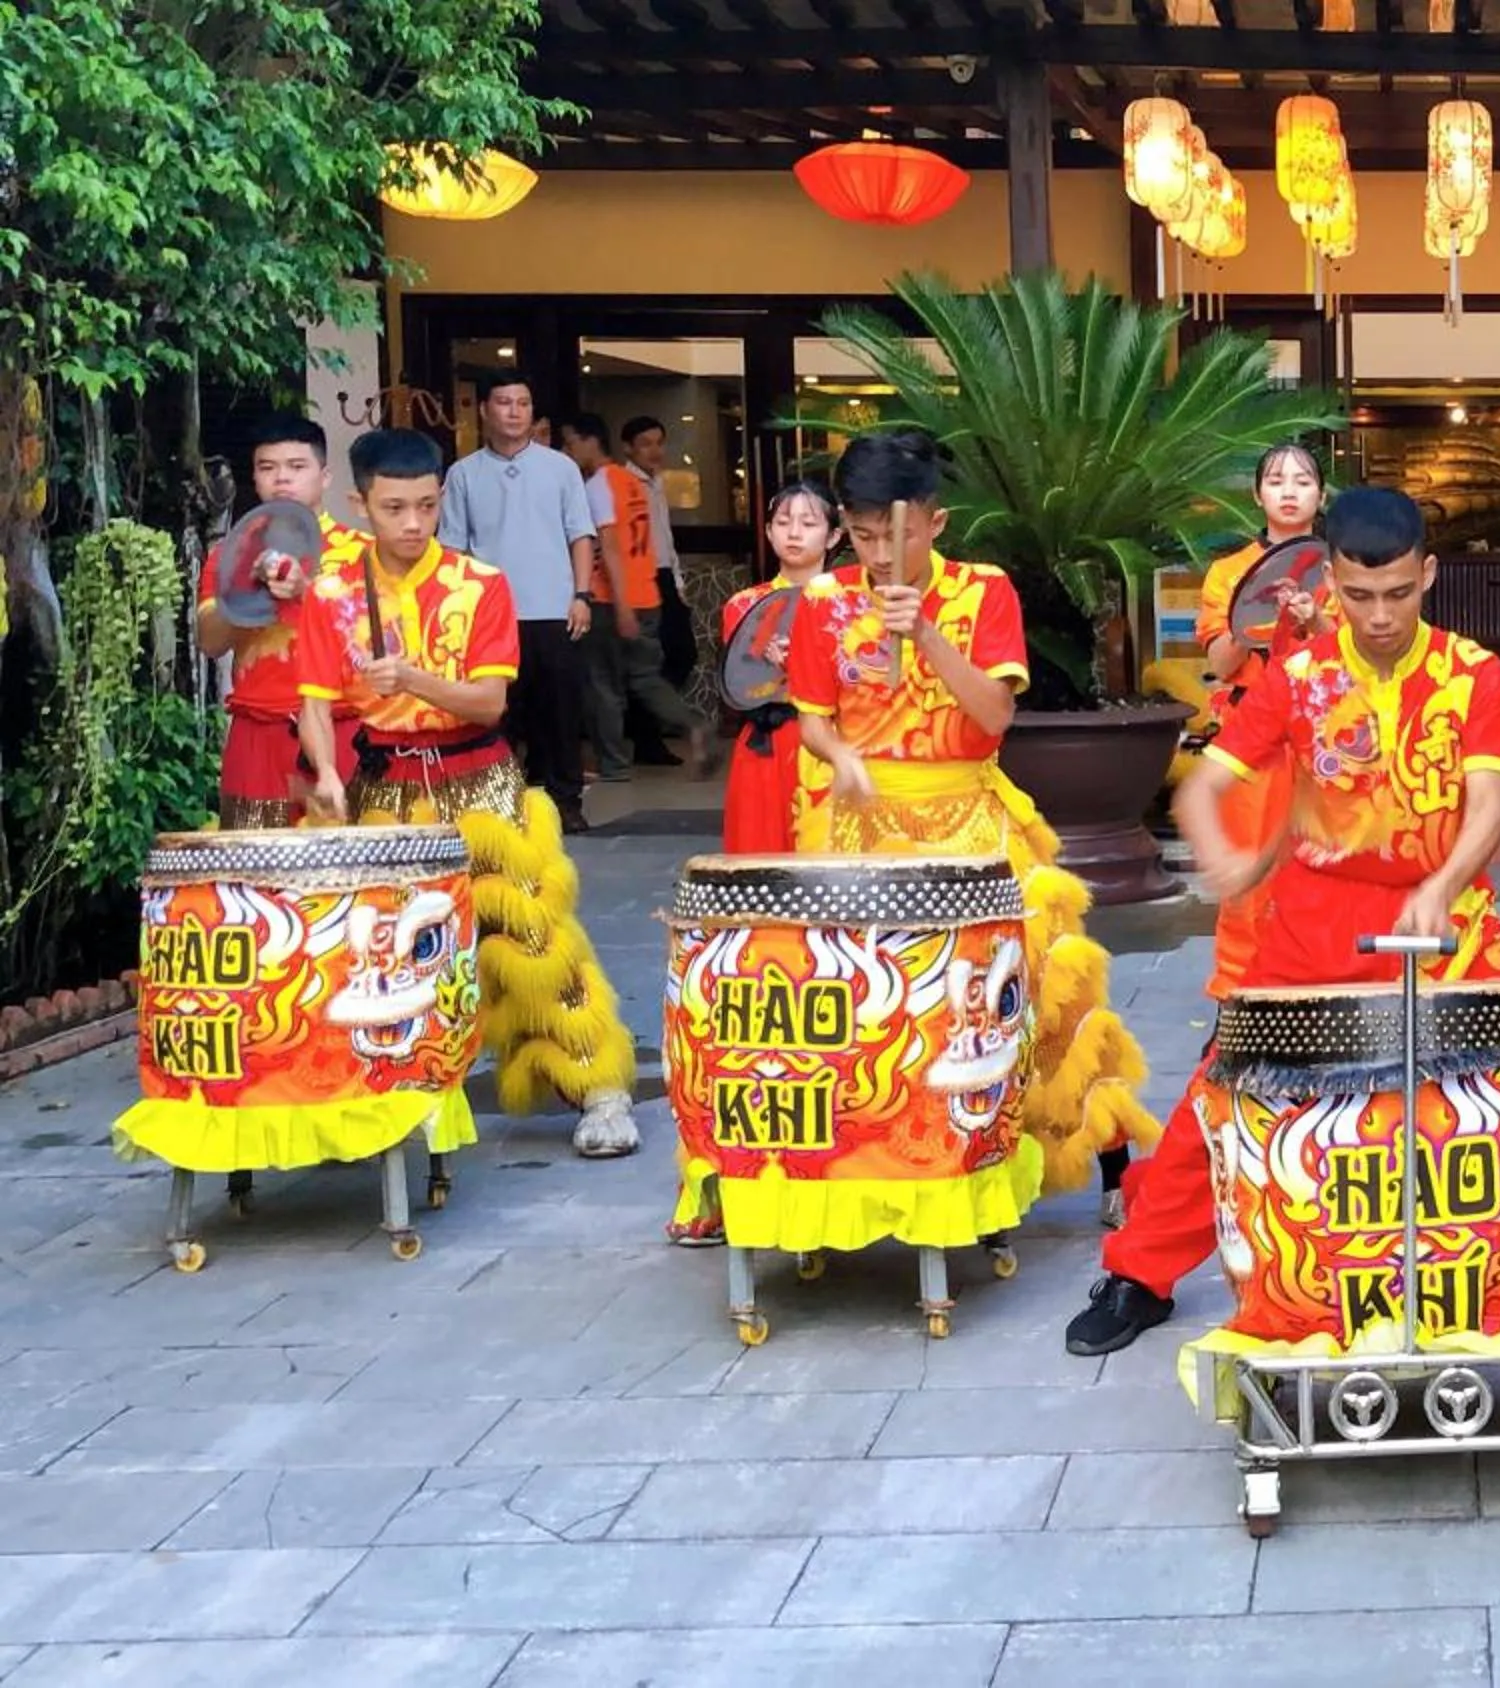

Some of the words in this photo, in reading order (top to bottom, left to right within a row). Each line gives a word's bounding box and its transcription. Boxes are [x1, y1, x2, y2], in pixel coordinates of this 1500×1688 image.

[148, 916, 251, 984] HÀO
[154, 1008, 237, 1075] KHÍ
[713, 973, 849, 1047] HÀO
[716, 1072, 832, 1147] KHÍ
[1325, 1130, 1497, 1226] HÀO
[1346, 1245, 1485, 1331] KHÍ
